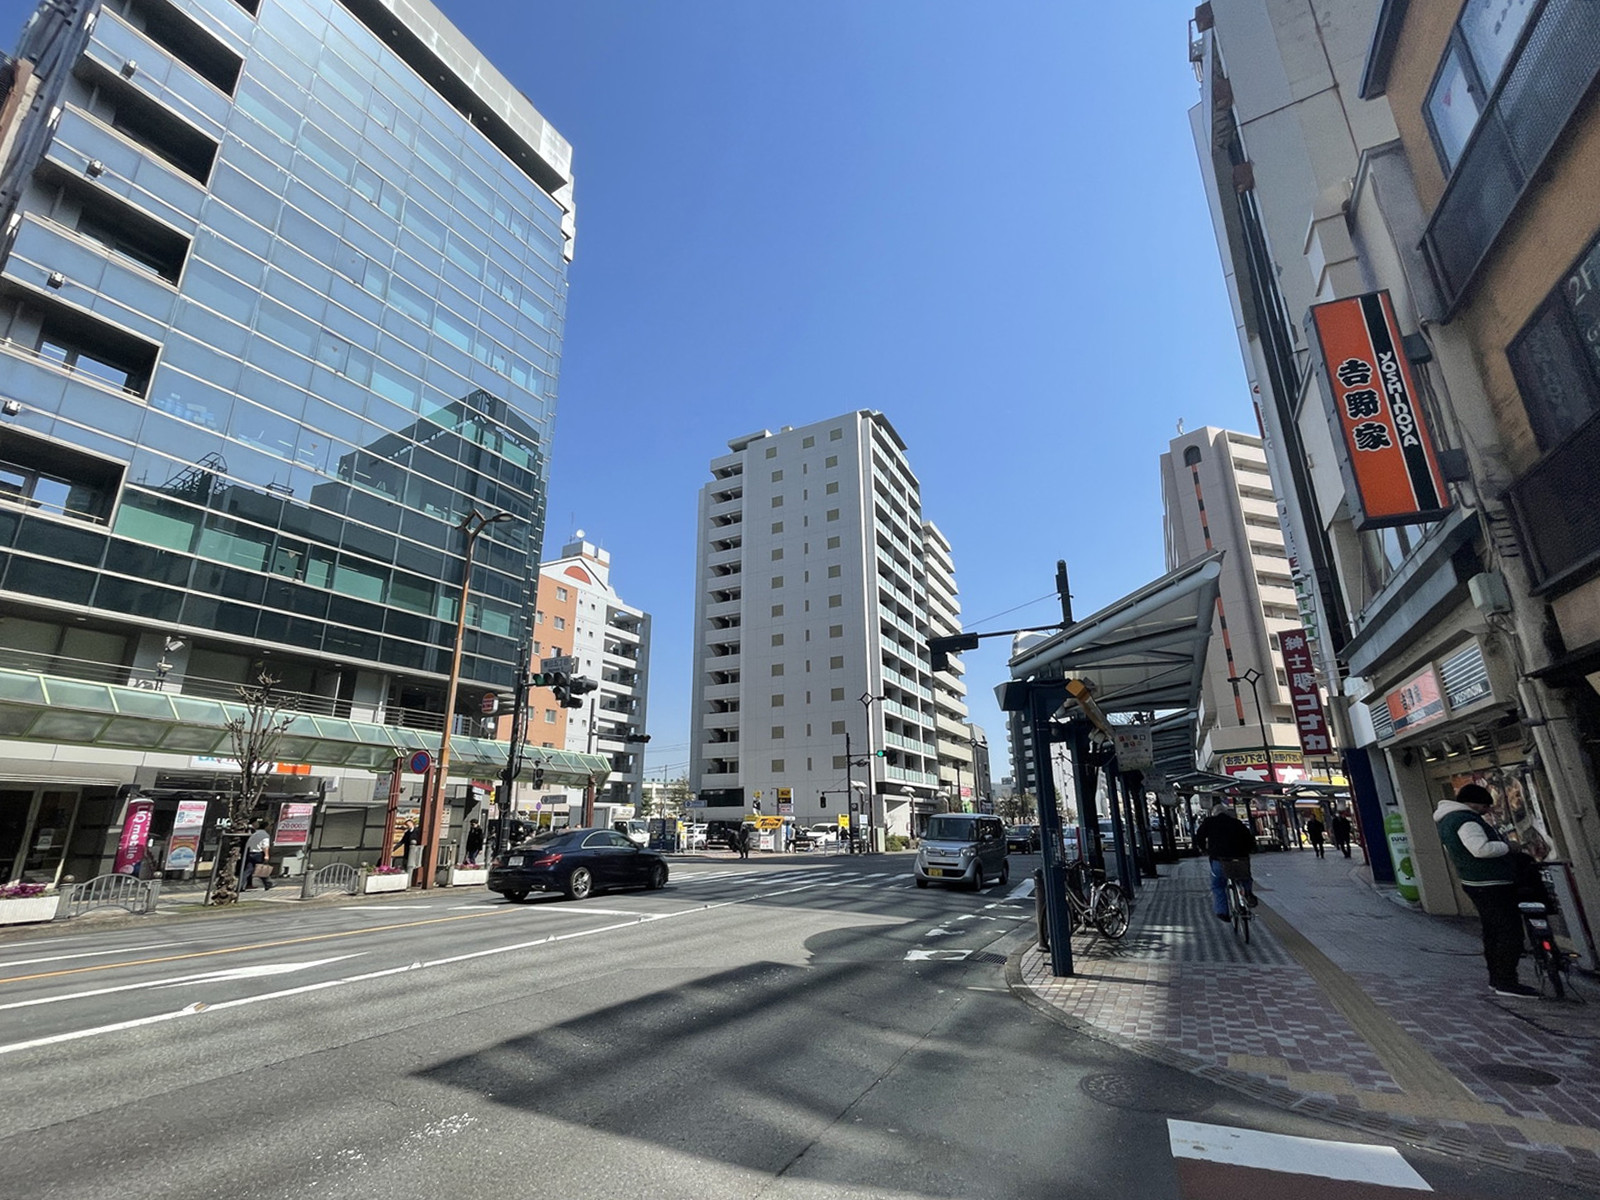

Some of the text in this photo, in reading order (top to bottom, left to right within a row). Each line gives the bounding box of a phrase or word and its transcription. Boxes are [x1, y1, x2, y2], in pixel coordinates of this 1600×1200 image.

[1336, 358, 1393, 452] 吉野家
[1378, 351, 1419, 448] YOSHINOYA
[126, 824, 140, 859] mobile
